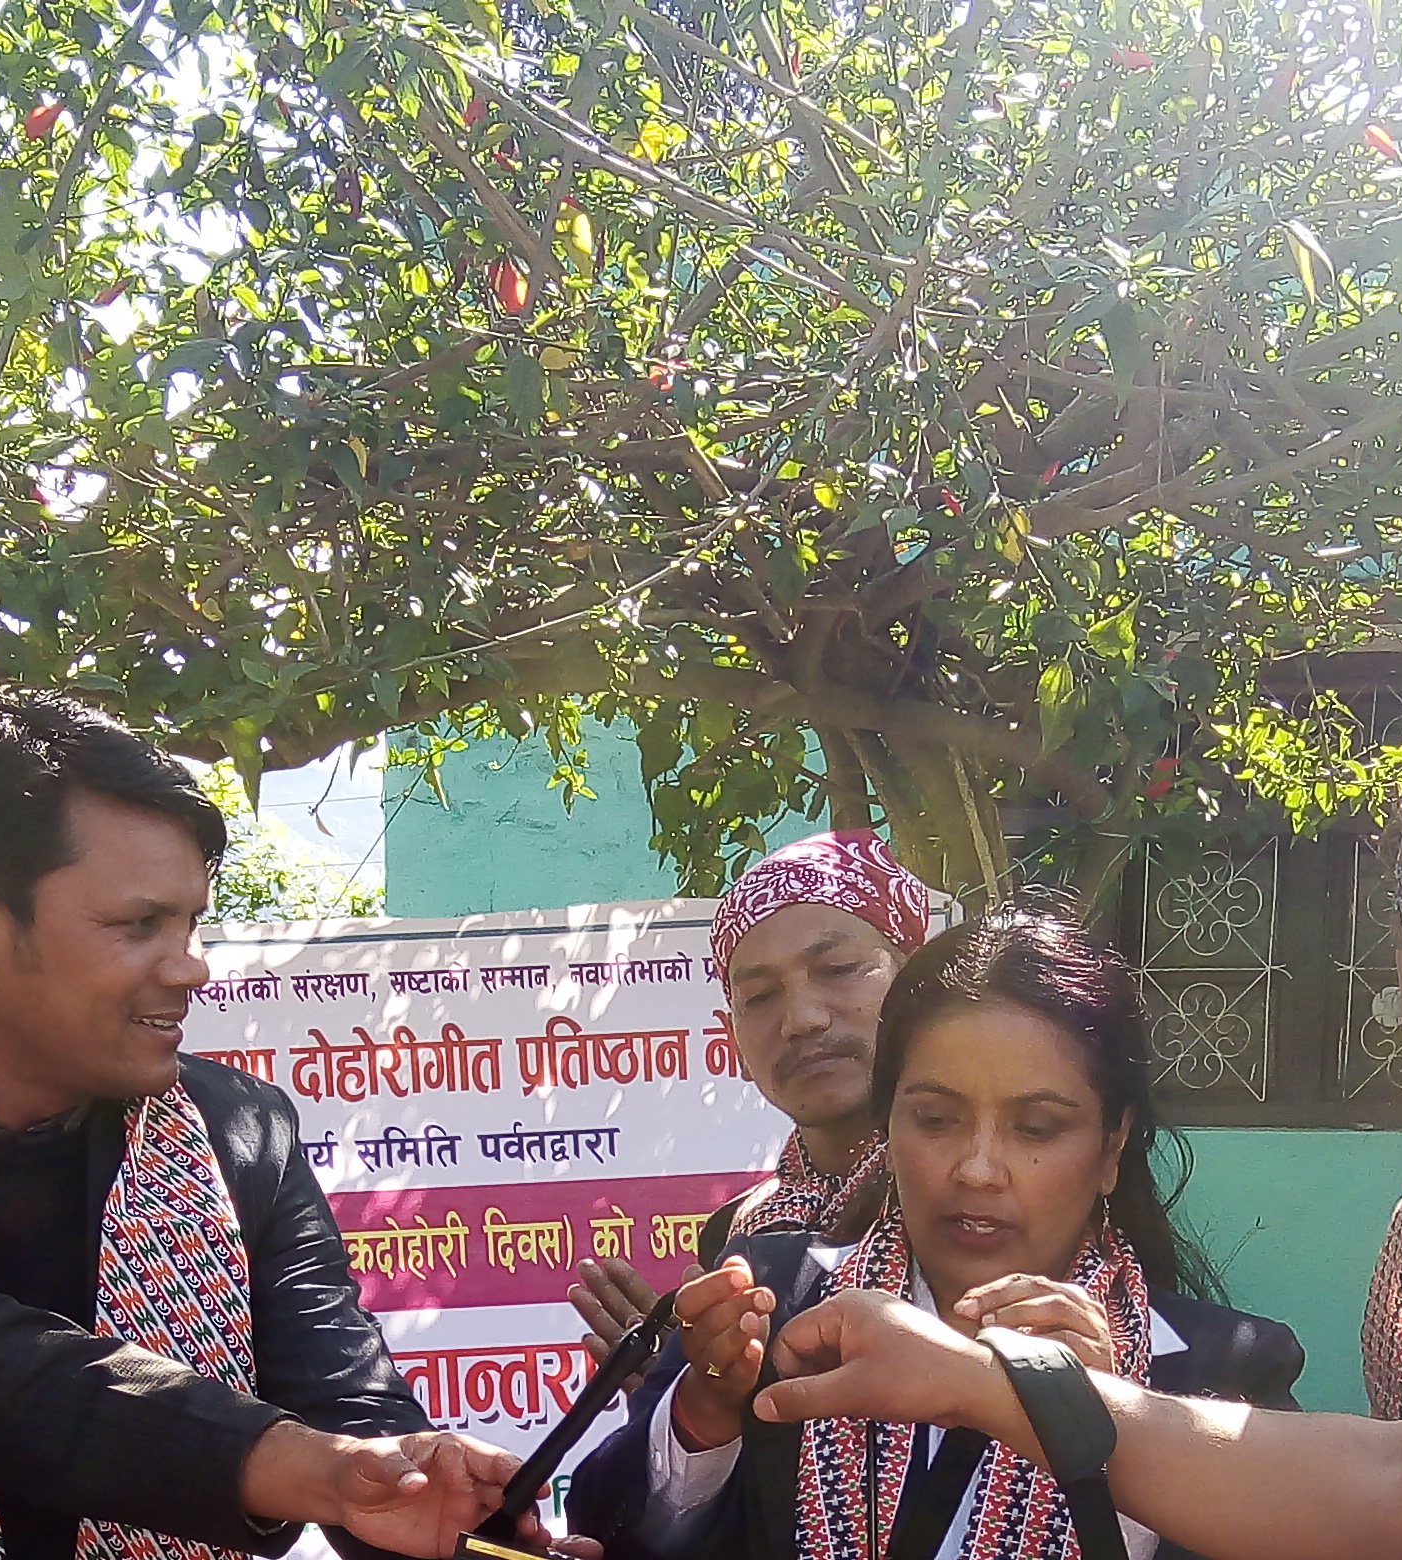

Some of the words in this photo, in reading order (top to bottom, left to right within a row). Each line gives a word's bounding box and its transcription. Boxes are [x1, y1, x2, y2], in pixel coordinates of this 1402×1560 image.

[290, 969, 377, 1003] संरक्षण,
[568, 952, 693, 988] नवप्रतिभाको
[289, 1022, 502, 1104] दोहोरीगीत
[516, 1014, 690, 1097] प्रतिष्ठान
[356, 1125, 462, 1172] समिति
[476, 1122, 621, 1165] पर्वतद्वारा
[482, 1206, 574, 1275] दिवस)
[590, 1204, 635, 1259] को
